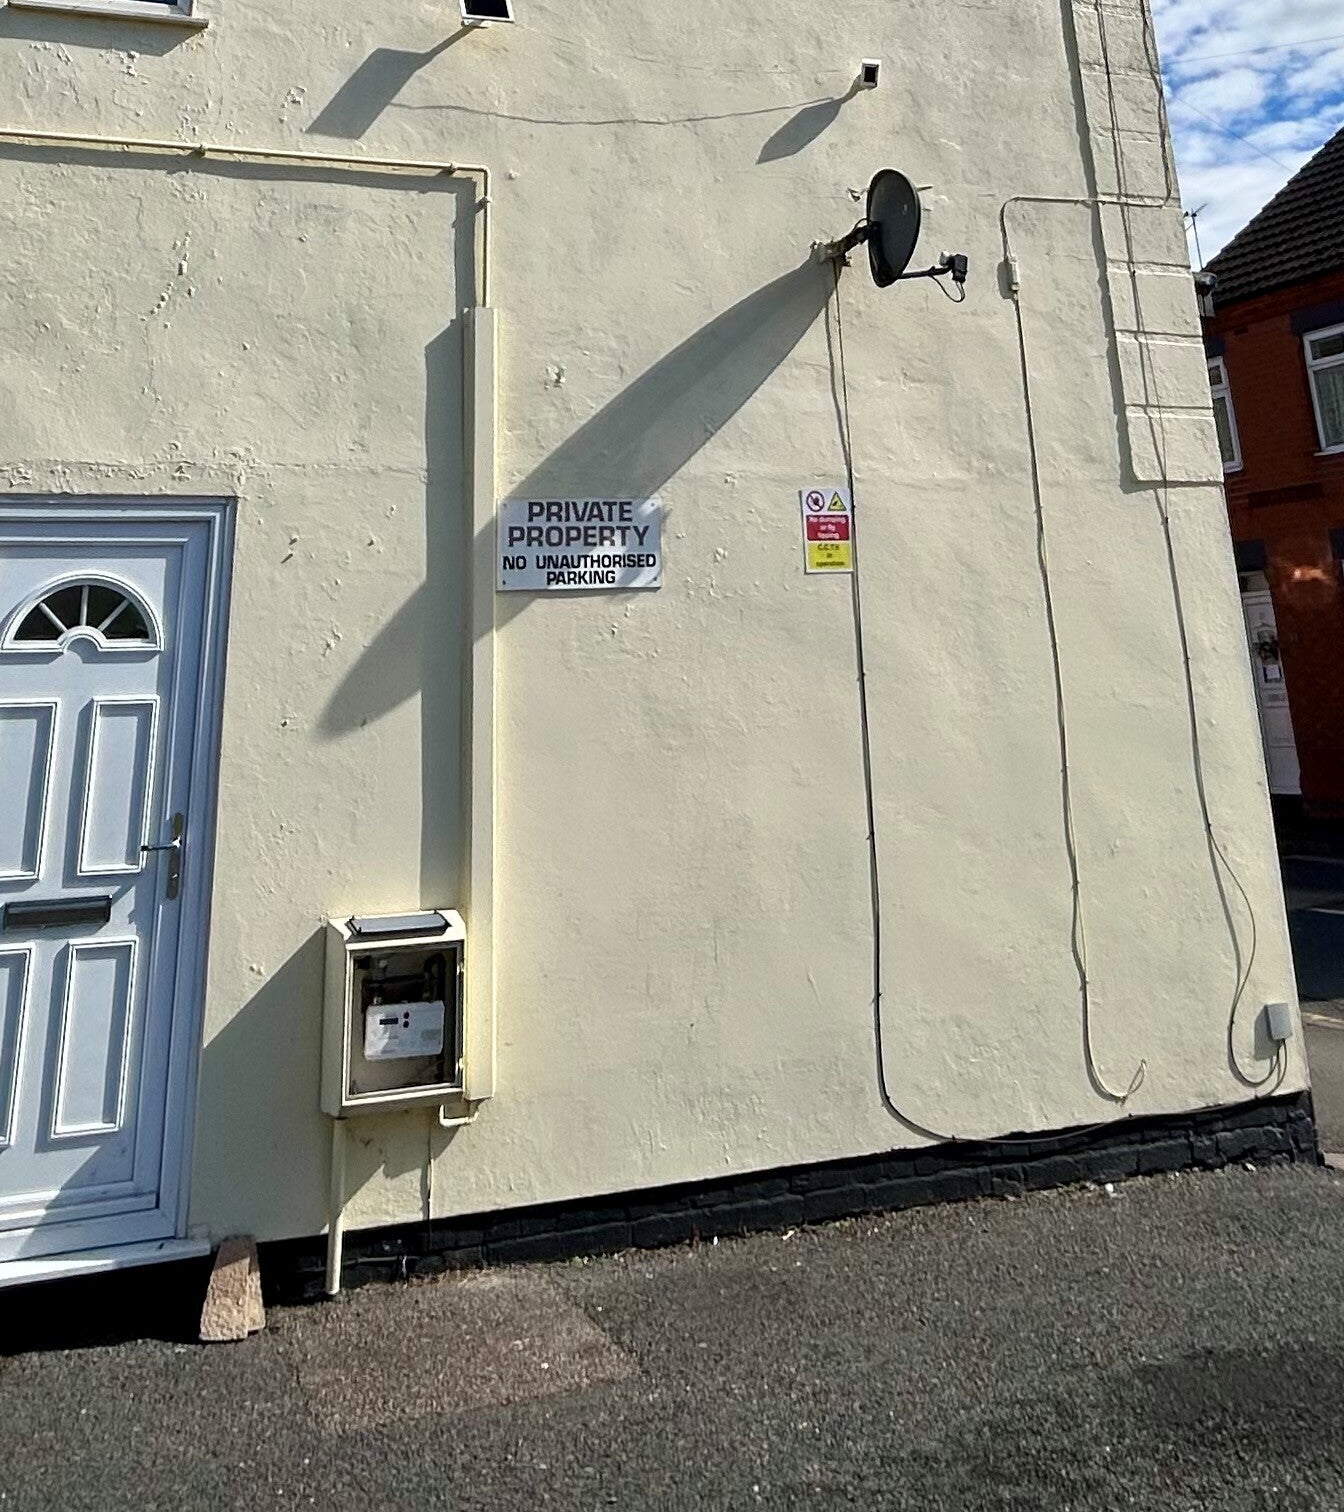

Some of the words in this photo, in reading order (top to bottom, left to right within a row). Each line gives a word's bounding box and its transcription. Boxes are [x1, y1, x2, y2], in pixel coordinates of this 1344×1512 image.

[528, 501, 633, 523] PRIVATE
[508, 525, 650, 548] PROPERTY
[502, 555, 527, 570] NO
[536, 554, 656, 570] UNAUTHORISED
[547, 570, 616, 586] PARKING
